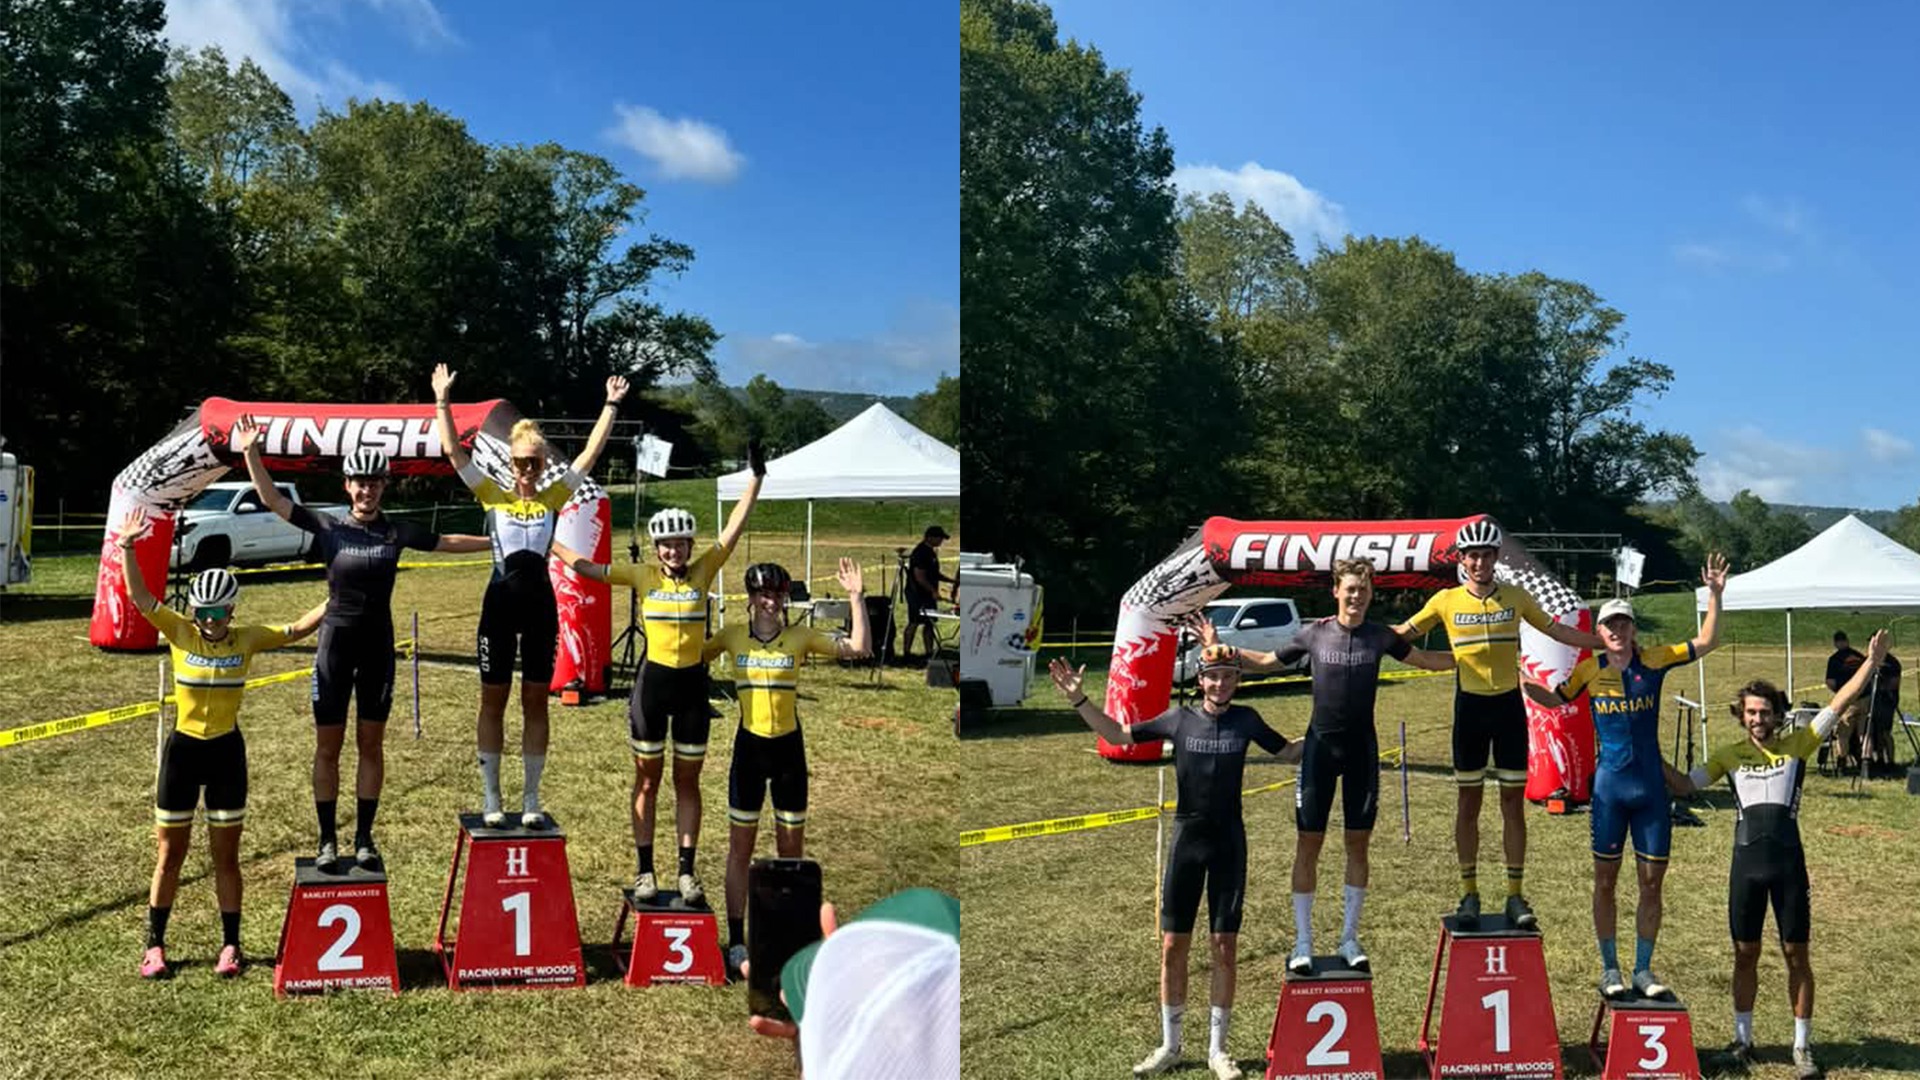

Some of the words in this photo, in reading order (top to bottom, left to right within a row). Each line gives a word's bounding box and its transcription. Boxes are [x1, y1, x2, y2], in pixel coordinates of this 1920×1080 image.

[230, 416, 443, 457] FINISH
[506, 509, 545, 522] SCAD
[1231, 533, 1438, 571] FINISH
[479, 635, 490, 672] SCAD
[1594, 694, 1654, 714] MARIAN
[1740, 757, 1785, 773] SCAD
[506, 847, 530, 876] H
[317, 904, 363, 971] 2
[502, 892, 531, 956] 1
[663, 927, 694, 973] 3
[1485, 946, 1508, 974] H
[285, 978, 322, 988] RACING
[323, 978, 334, 987] IN
[335, 977, 354, 986] THE
[355, 976, 392, 986] WOODS
[458, 967, 500, 978] RACING
[501, 967, 511, 976] IN
[512, 966, 534, 976] THE
[536, 965, 577, 975] WOODS
[1306, 1000, 1350, 1066] 2
[1481, 989, 1510, 1052] 1
[1638, 1025, 1668, 1070] 3
[1342, 1072, 1377, 1080] WOODS
[1441, 1064, 1481, 1074] RACING
[1481, 1064, 1492, 1073] IN
[1493, 1063, 1514, 1072] THE
[1516, 1062, 1555, 1071] WOODS
